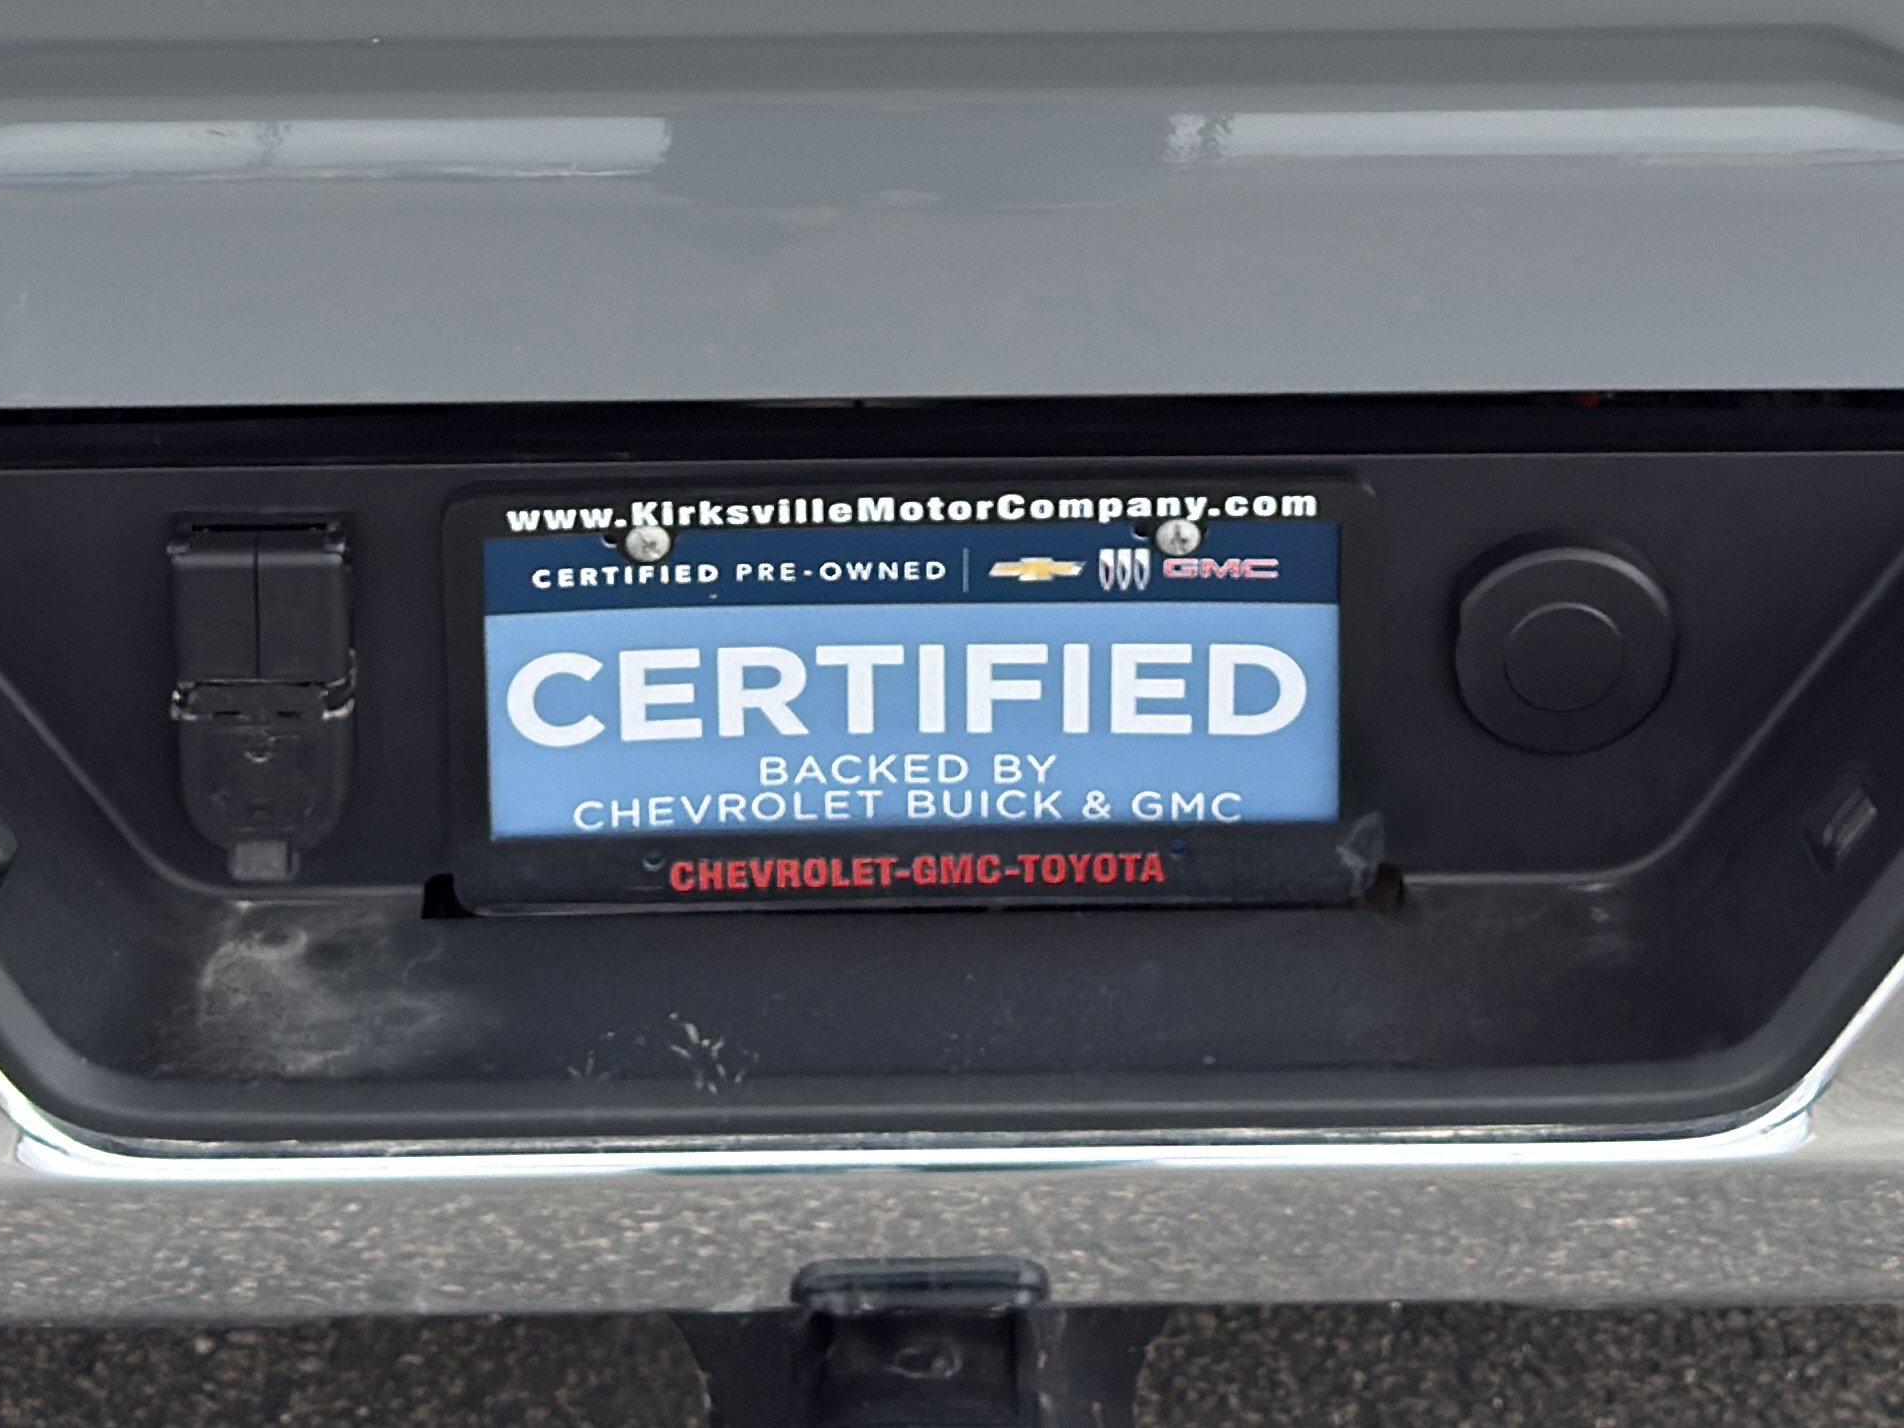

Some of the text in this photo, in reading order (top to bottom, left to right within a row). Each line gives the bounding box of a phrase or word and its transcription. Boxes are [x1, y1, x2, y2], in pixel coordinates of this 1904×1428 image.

[505, 493, 1319, 532] www.KirksvilleMotorCompany.com
[531, 558, 1280, 589] CERTIFIED PRE-OWNED GMC
[506, 642, 1308, 748] CERTIFIED
[759, 753, 1057, 787] BACKED BY
[572, 789, 1243, 832] CHEVROLET BUICK & GMC
[669, 852, 1167, 893] CHEVROLET-GMC-TOYOTA
